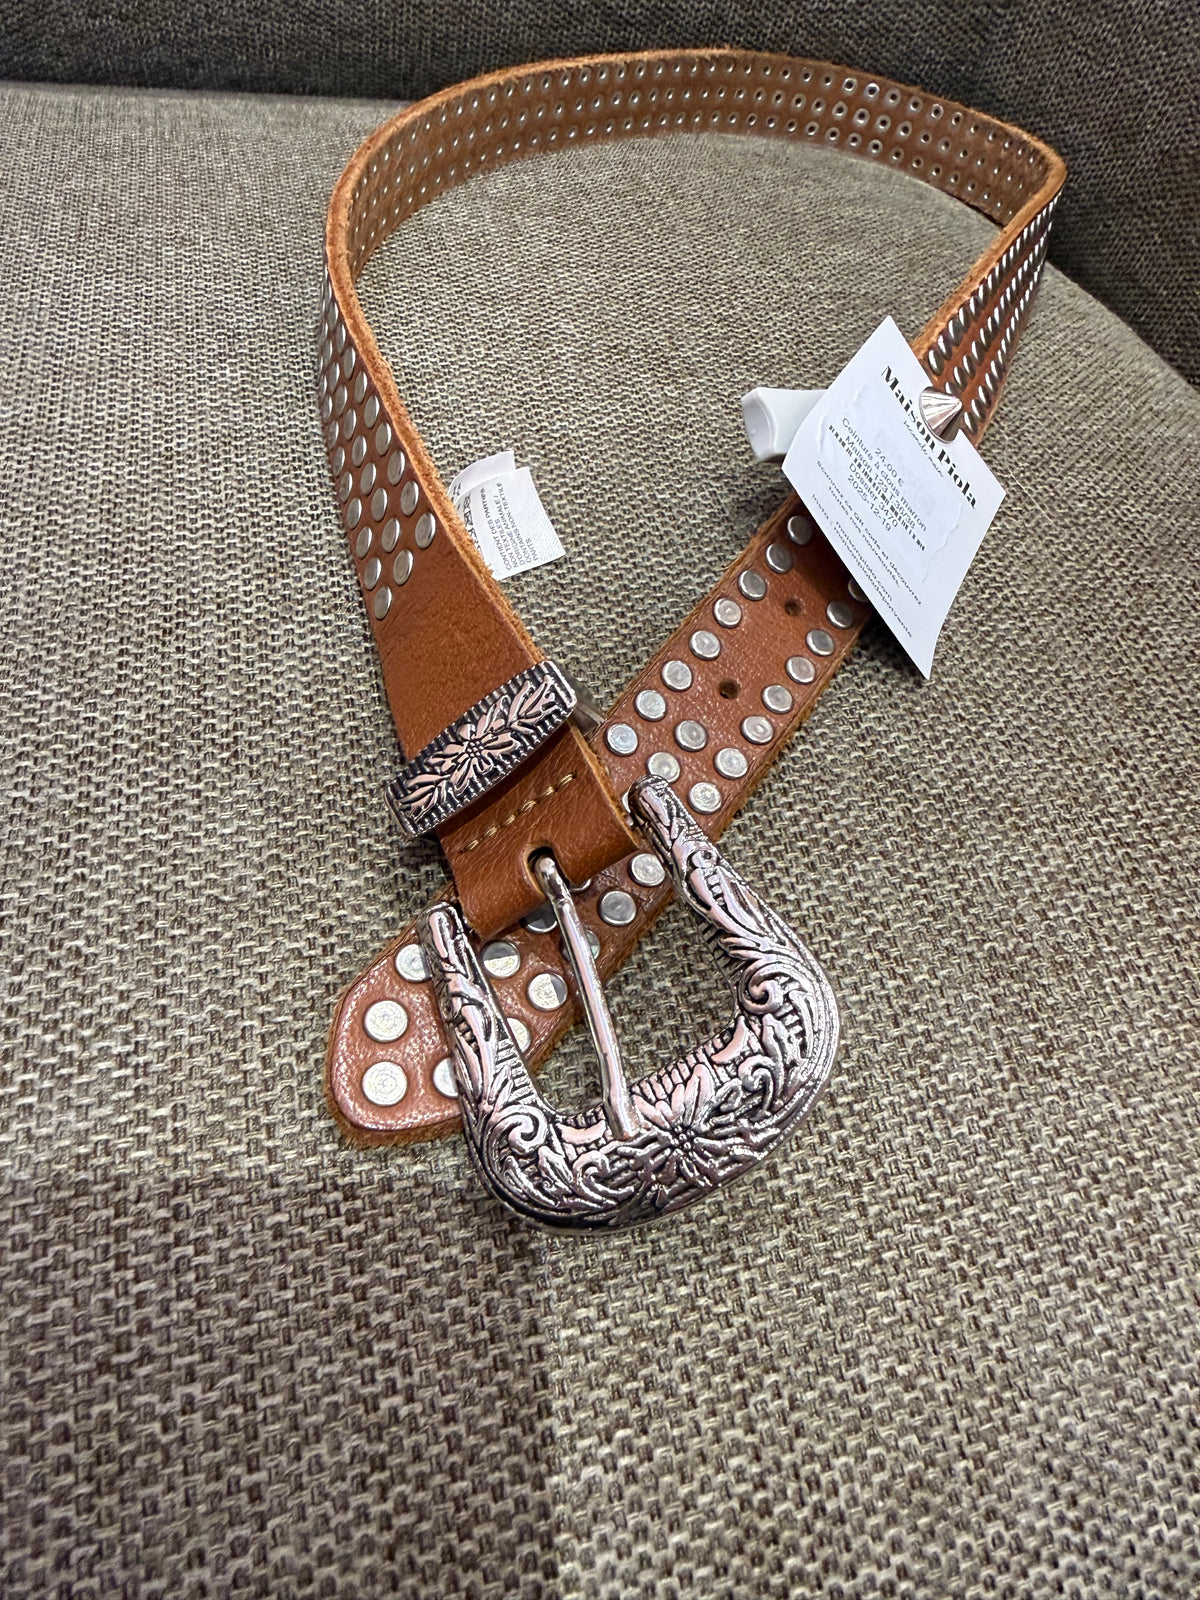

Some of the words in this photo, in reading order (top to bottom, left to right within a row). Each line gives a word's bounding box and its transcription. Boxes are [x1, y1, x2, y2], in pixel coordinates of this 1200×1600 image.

[881, 365, 935, 451] Maison
[937, 448, 976, 508] Piola
[843, 417, 872, 460] Ceinture
[881, 470, 899, 496] clous
[900, 496, 926, 531] marron
[845, 435, 872, 472] Maison
[875, 473, 888, 492] 123
[849, 462, 878, 501] Dossier
[878, 501, 898, 527] 3470
[898, 478, 904, 486] €
[487, 519, 497, 534] DES
[494, 499, 510, 528] ANIMALE
[817, 460, 843, 499] Scannez
[853, 512, 864, 526] QR
[864, 528, 880, 549] code
[881, 551, 888, 560] et
[492, 533, 512, 570] CONTIENT
[494, 518, 510, 551] TEXTILES
[512, 528, 532, 563] CONTAINS
[524, 537, 539, 560] PARTS
[507, 551, 518, 568] NON
